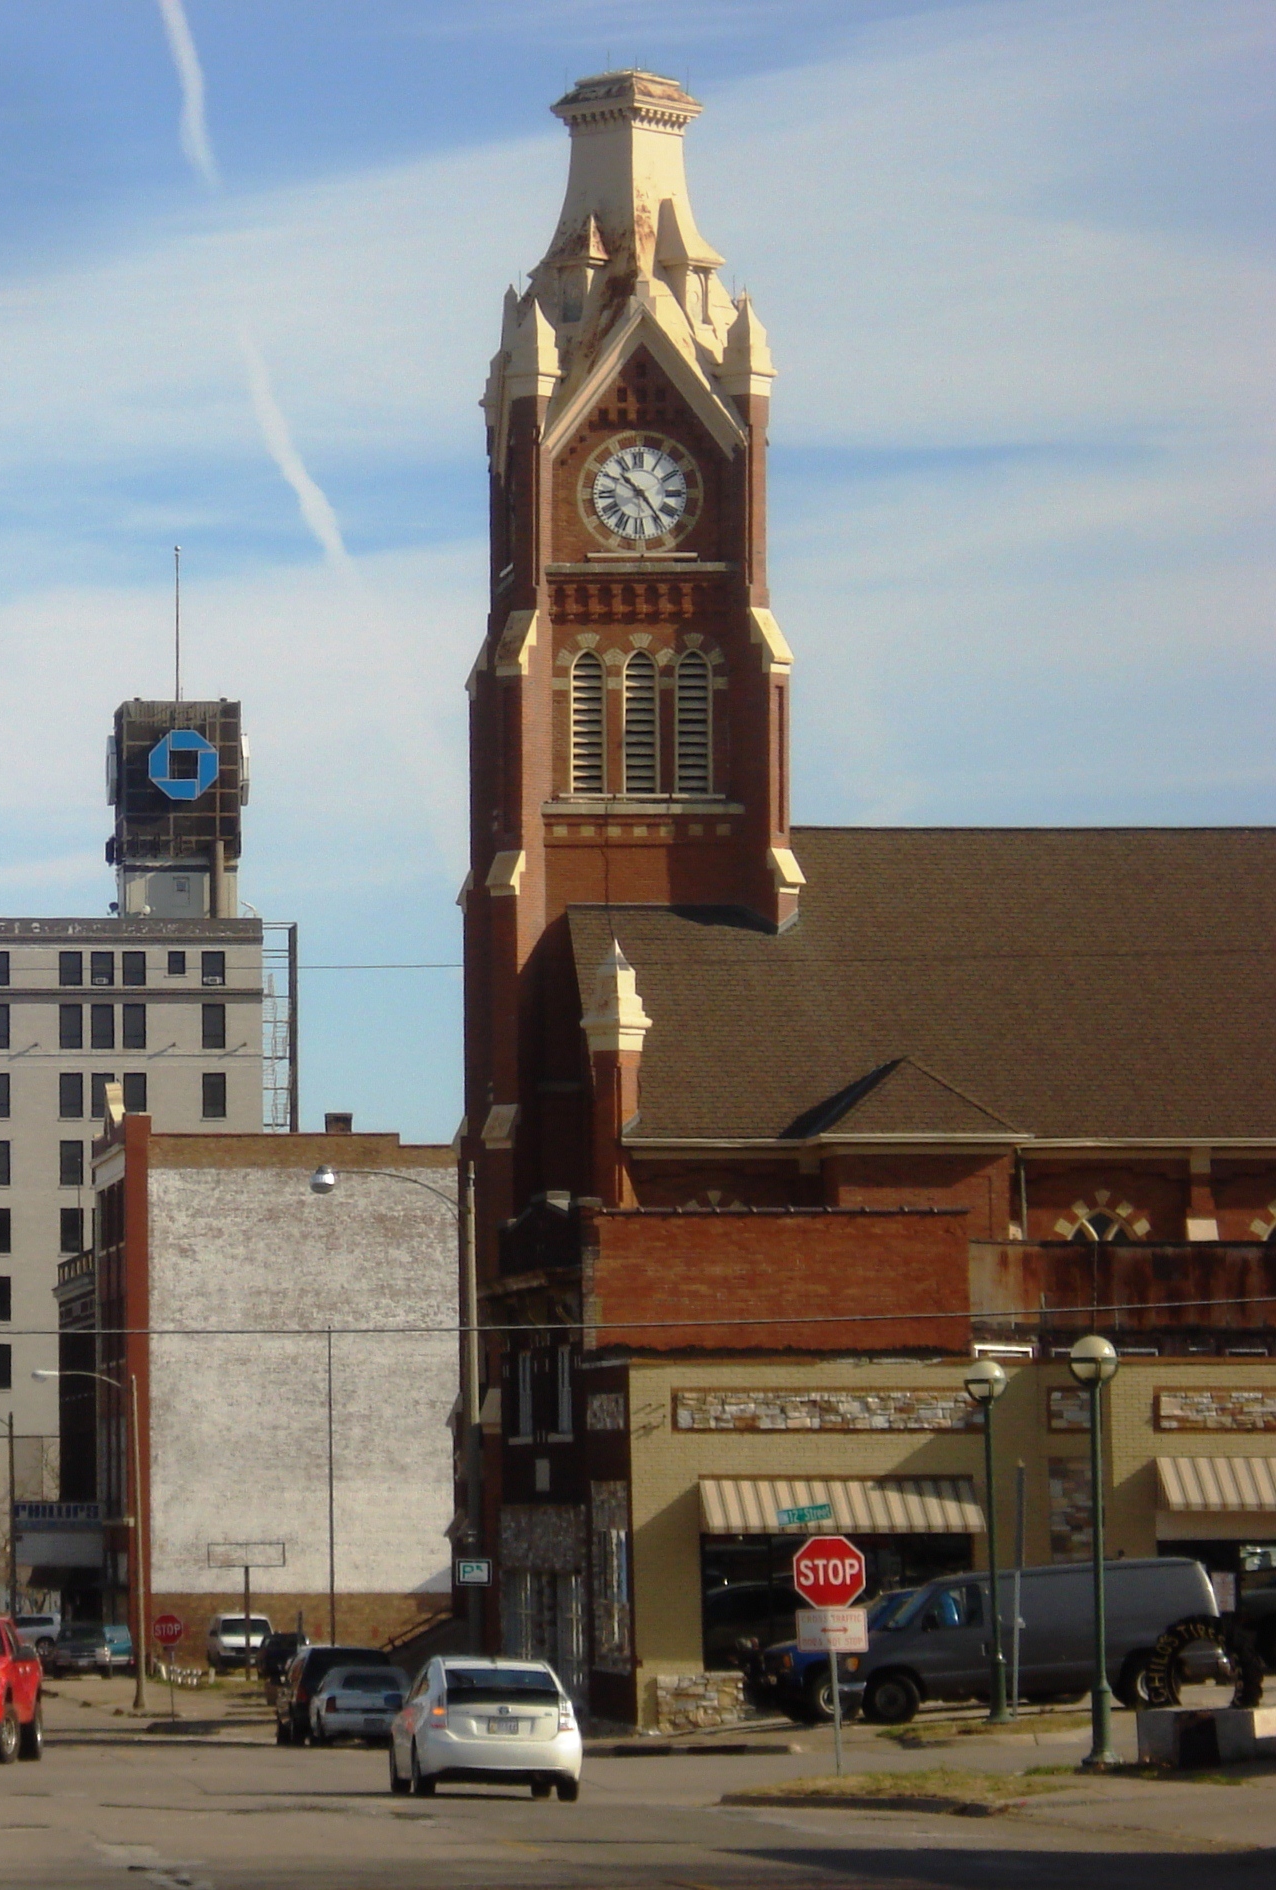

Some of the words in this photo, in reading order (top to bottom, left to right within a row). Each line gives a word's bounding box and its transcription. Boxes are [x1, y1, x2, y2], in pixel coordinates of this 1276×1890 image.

[804, 1505, 831, 1521] Street
[462, 1564, 475, 1580] P
[799, 1558, 860, 1587] STOP
[831, 1614, 863, 1623] TRAFFIC
[154, 1623, 182, 1637] STOP
[845, 1636, 863, 1646] STOP
